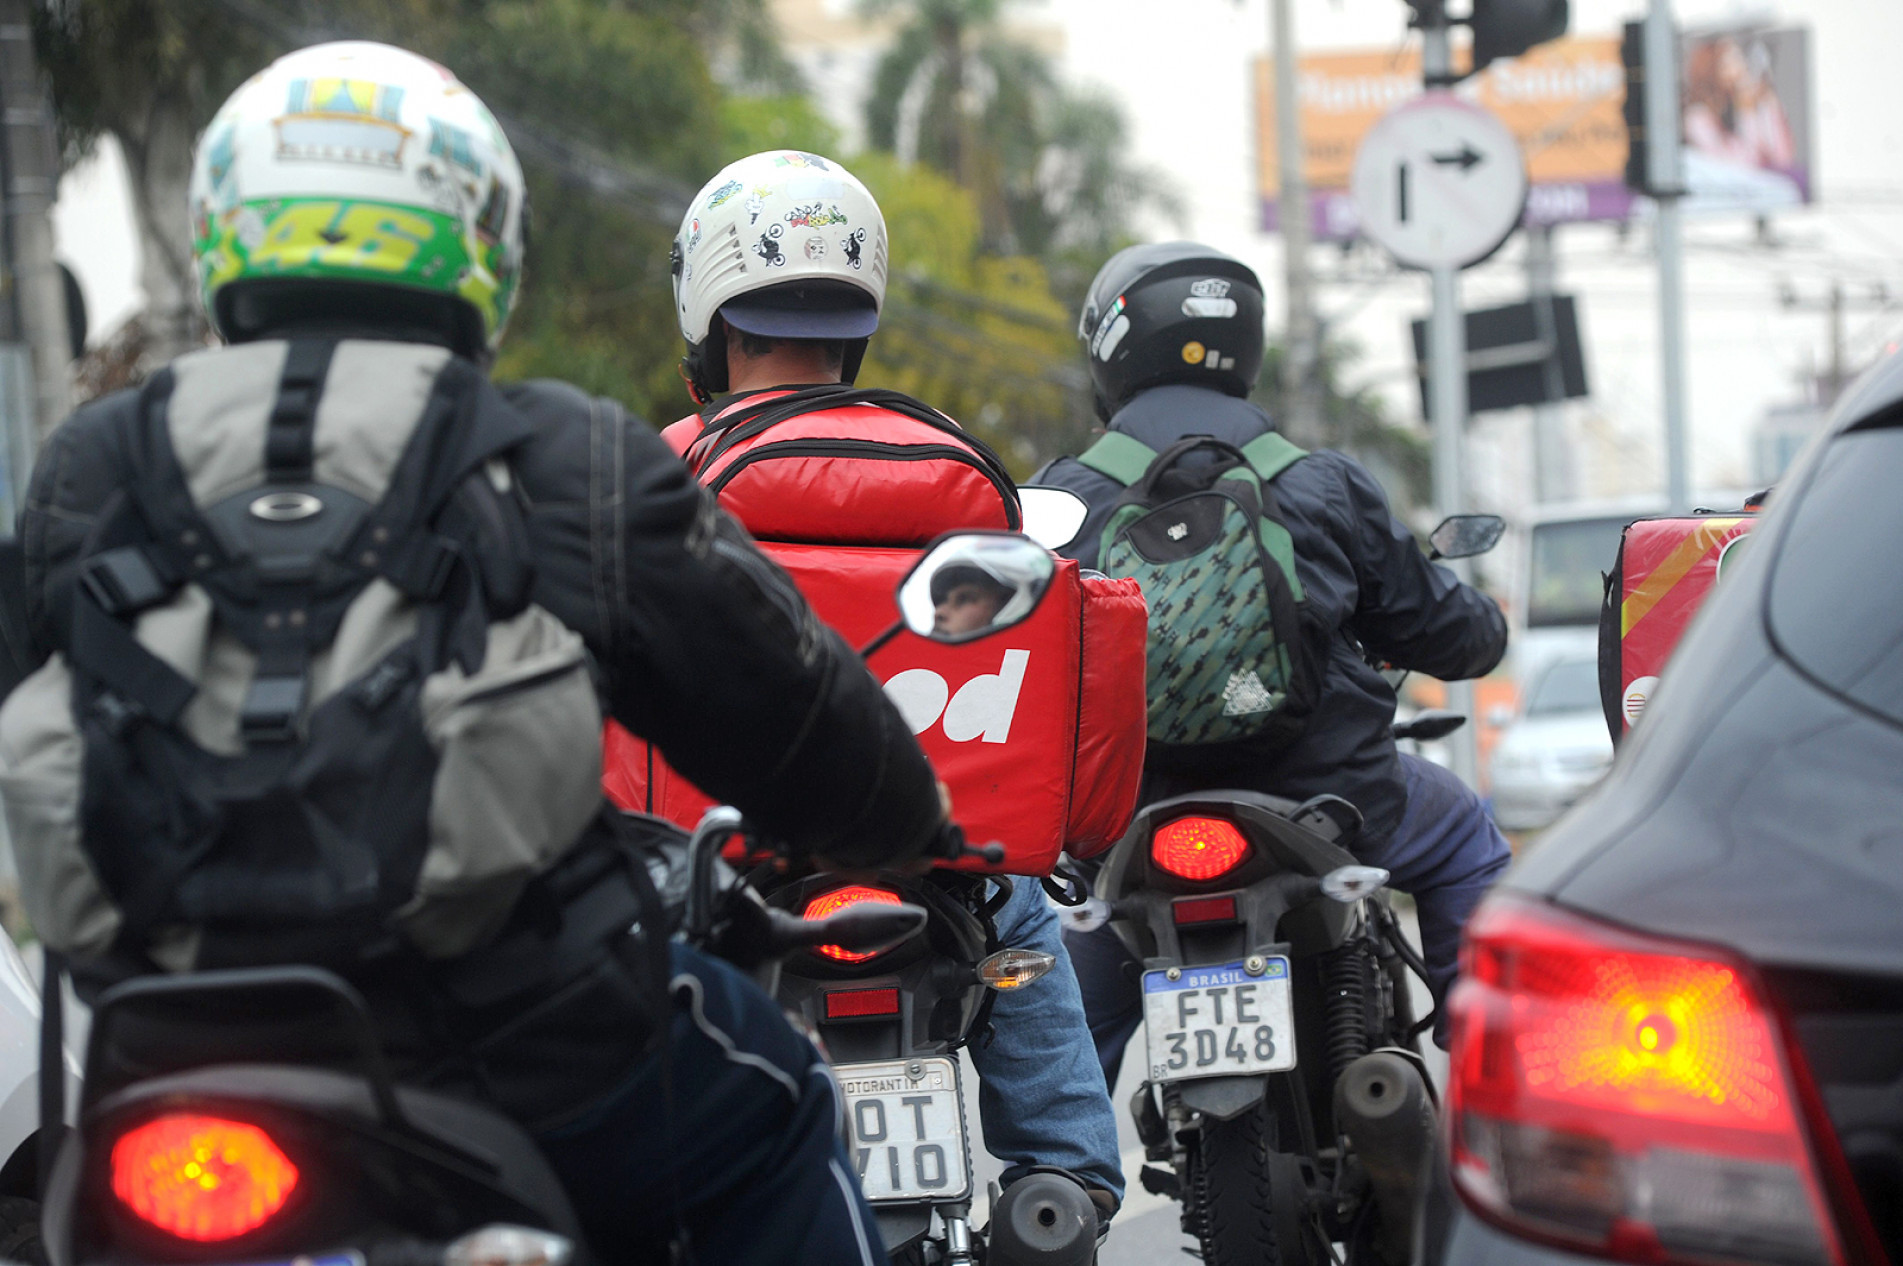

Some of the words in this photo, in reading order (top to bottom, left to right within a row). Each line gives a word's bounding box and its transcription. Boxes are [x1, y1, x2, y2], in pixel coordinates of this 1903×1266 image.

[249, 203, 435, 273] 46
[1189, 972, 1243, 987] BRASIL
[1177, 985, 1260, 1028] FTE
[1165, 1025, 1276, 1070] 3D48
[1153, 1064, 1168, 1079] BR
